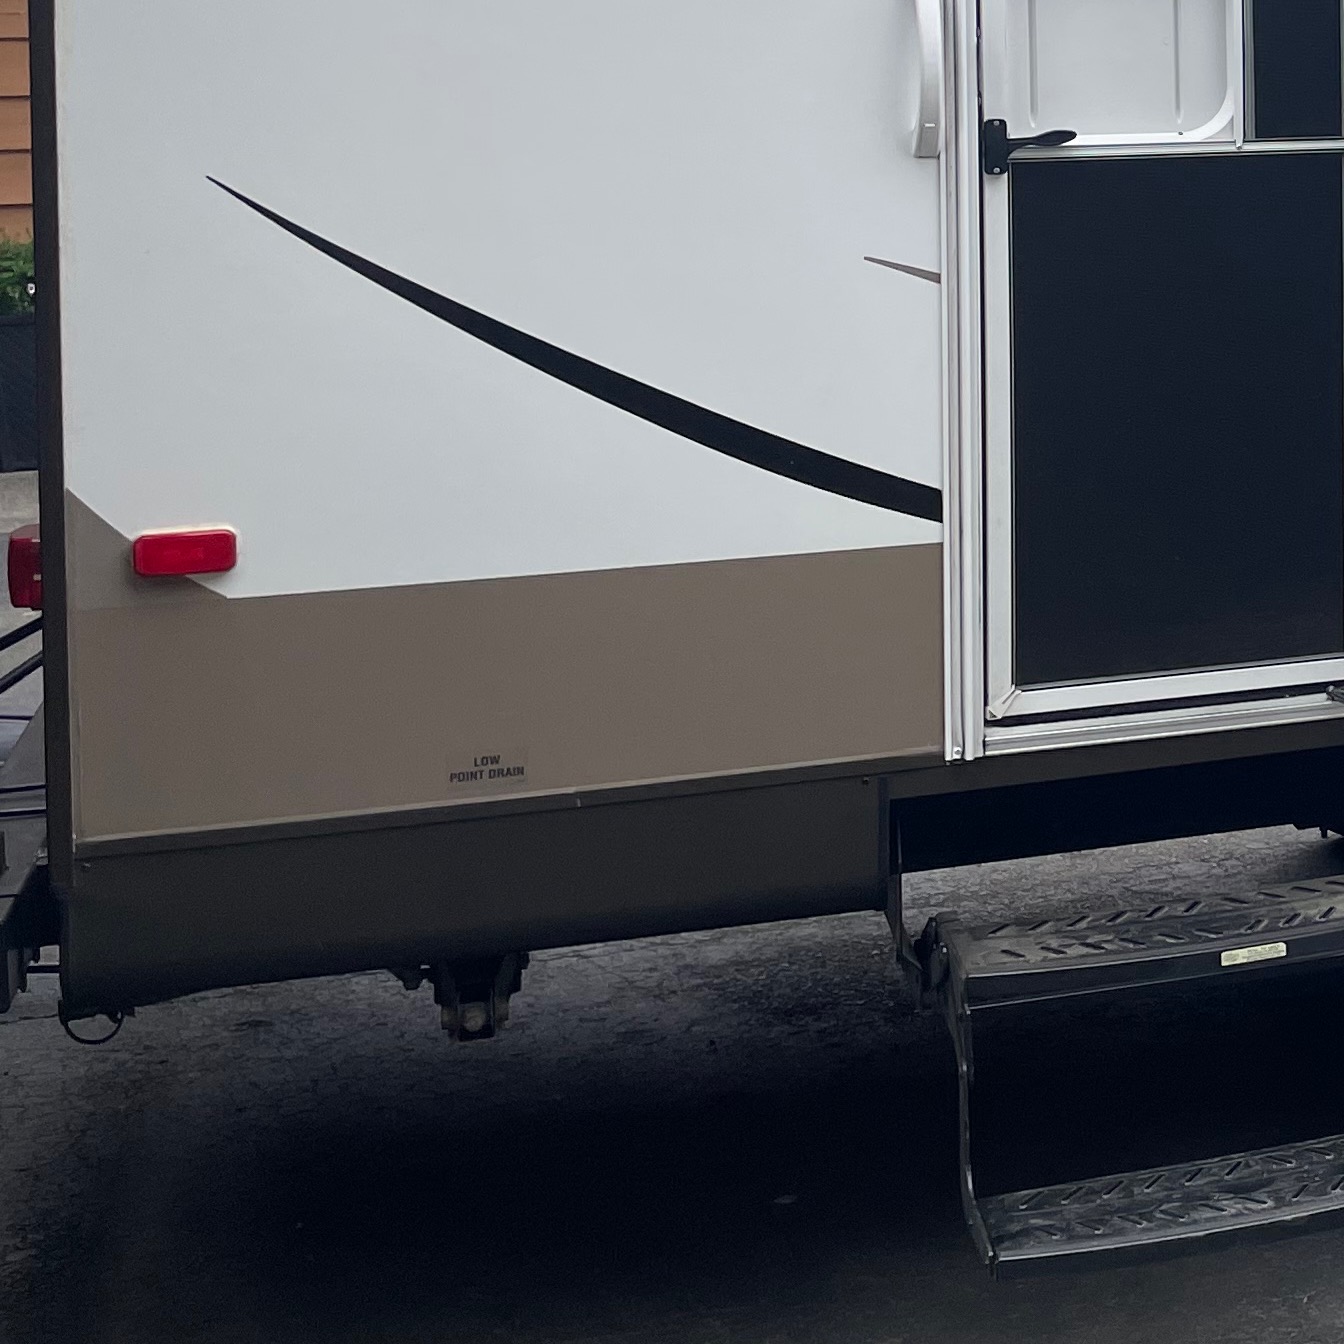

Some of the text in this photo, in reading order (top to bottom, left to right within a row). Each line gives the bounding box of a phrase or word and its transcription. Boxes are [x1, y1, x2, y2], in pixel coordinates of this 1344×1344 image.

[474, 755, 501, 767] LOW
[449, 765, 525, 783] POINT DRAIN
